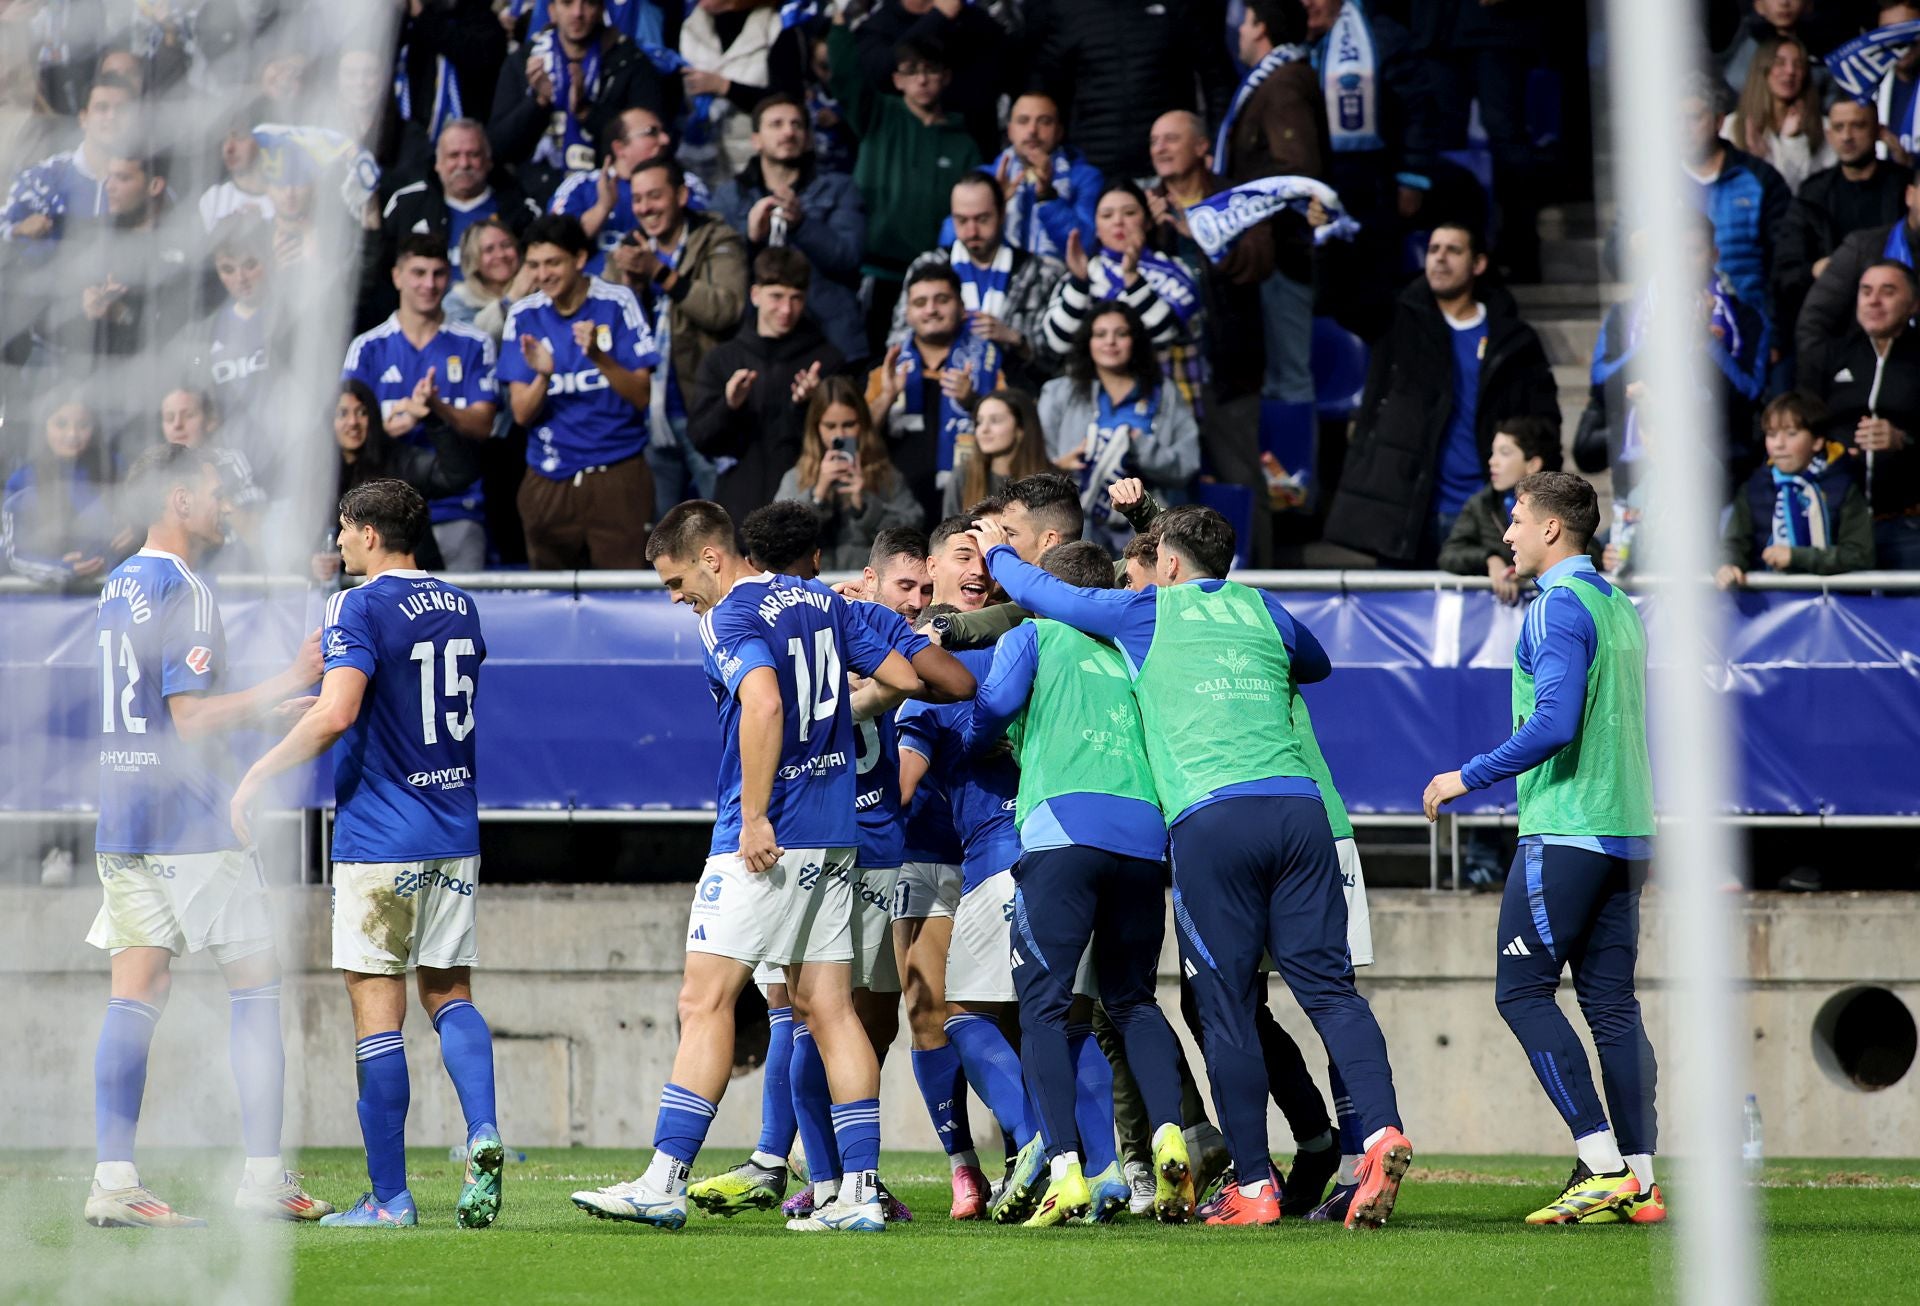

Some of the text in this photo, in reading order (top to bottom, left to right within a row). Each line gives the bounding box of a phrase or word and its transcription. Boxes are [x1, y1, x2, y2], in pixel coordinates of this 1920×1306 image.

[546, 367, 611, 397] DIG
[398, 590, 468, 622] LUENGO
[98, 629, 148, 734] 12
[409, 638, 476, 745] 15
[787, 626, 841, 742] 14
[1194, 677, 1278, 694] CAJA RURAL
[1211, 691, 1271, 702] DE ASTURIAS
[107, 751, 161, 766] HYUNDAI
[418, 868, 473, 897] DETOOLS
